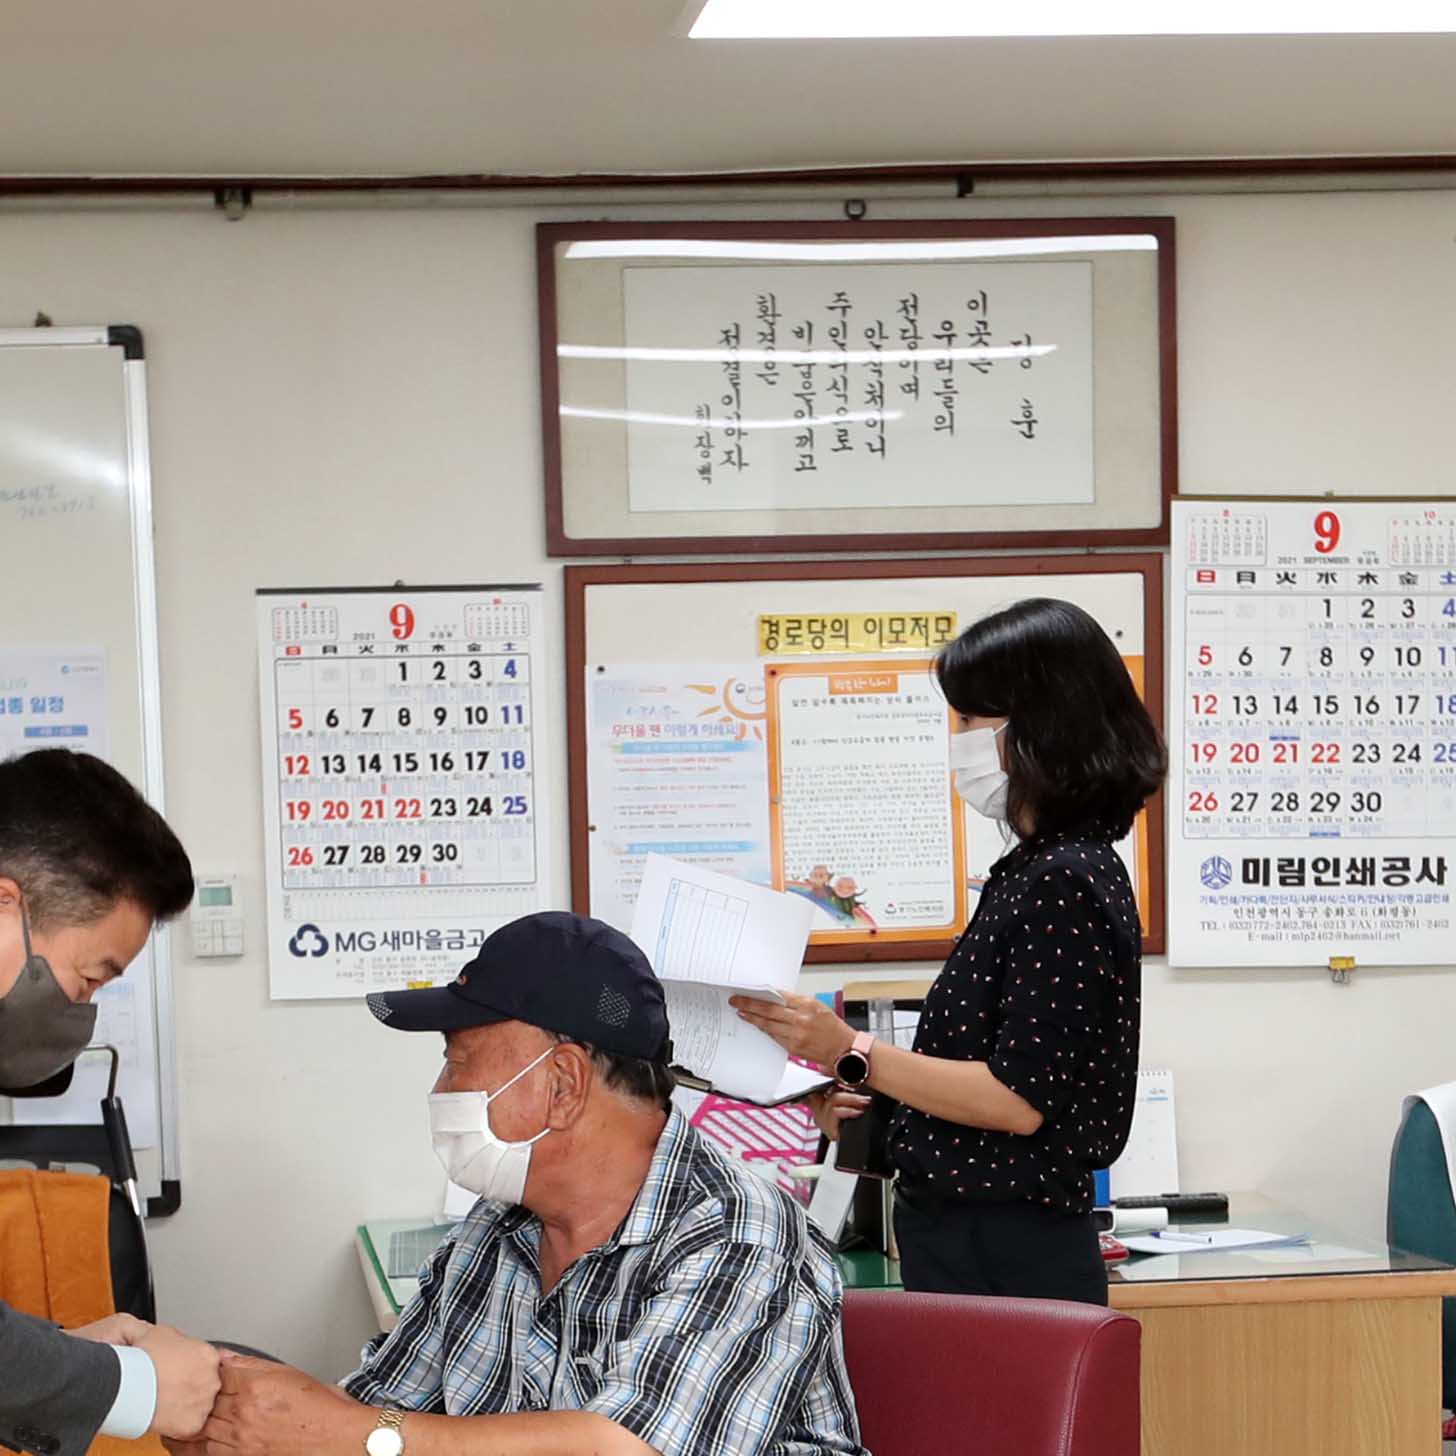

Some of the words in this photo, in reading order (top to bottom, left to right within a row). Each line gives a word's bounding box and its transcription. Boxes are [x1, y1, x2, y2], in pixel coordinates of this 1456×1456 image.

[1314, 512, 1340, 553] 9
[1278, 556, 1297, 564] 2021
[1304, 556, 1350, 564] SEPTEMBER
[1324, 599, 1330, 618] 1
[1362, 599, 1374, 618] 2
[1402, 599, 1415, 618] 3
[1442, 599, 1456, 617] 4
[390, 604, 414, 640] 9
[761, 618, 849, 651] 경로당의
[864, 616, 954, 647] 이모저모
[1199, 646, 1212, 665] 5
[1239, 647, 1252, 666] 6
[1280, 647, 1292, 666] 7
[1320, 647, 1332, 666] 8
[1360, 647, 1374, 666] 9
[1395, 647, 1421, 666] 10
[399, 662, 406, 681] 1
[433, 661, 445, 680] 2
[469, 660, 482, 679] 3
[504, 659, 517, 678] 4
[31, 696, 64, 713] 일정
[1193, 695, 1217, 714] 12
[1233, 696, 1257, 715] 13
[1274, 696, 1298, 714] 14
[1314, 695, 1338, 714] 15
[1354, 696, 1379, 714] 16
[1396, 695, 1419, 714] 17
[289, 709, 302, 729] 5
[326, 709, 339, 728] 6
[362, 708, 374, 727] 7
[398, 708, 410, 726] 8
[434, 707, 446, 726] 9
[465, 707, 488, 725] 10
[502, 705, 522, 724] 11
[285, 755, 309, 775] 12
[322, 755, 345, 774] 13
[358, 754, 381, 773] 14
[394, 753, 418, 772] 15
[430, 752, 453, 771] 16
[466, 751, 489, 770] 17
[501, 751, 525, 769] 18
[1192, 743, 1217, 762] 19
[1231, 743, 1259, 763] 20
[1274, 743, 1297, 763] 21
[1312, 744, 1339, 763] 22
[1353, 744, 1380, 763] 23
[1393, 744, 1421, 762] 24
[287, 801, 310, 820] 19
[322, 800, 349, 820] 20
[361, 800, 383, 819] 21
[395, 799, 421, 818] 22
[431, 798, 456, 816] 23
[467, 797, 492, 816] 24
[503, 796, 527, 814] 25
[1190, 792, 1218, 811] 26
[1231, 792, 1258, 811] 27
[1272, 792, 1299, 811] 28
[1311, 792, 1340, 812] 29
[1351, 792, 1381, 812] 30
[289, 847, 313, 865] 26
[324, 846, 349, 865] 27
[361, 846, 385, 863] 28
[397, 845, 421, 863] 29
[433, 844, 457, 862] 30
[1242, 856, 1447, 887] 미림인쇄공사
